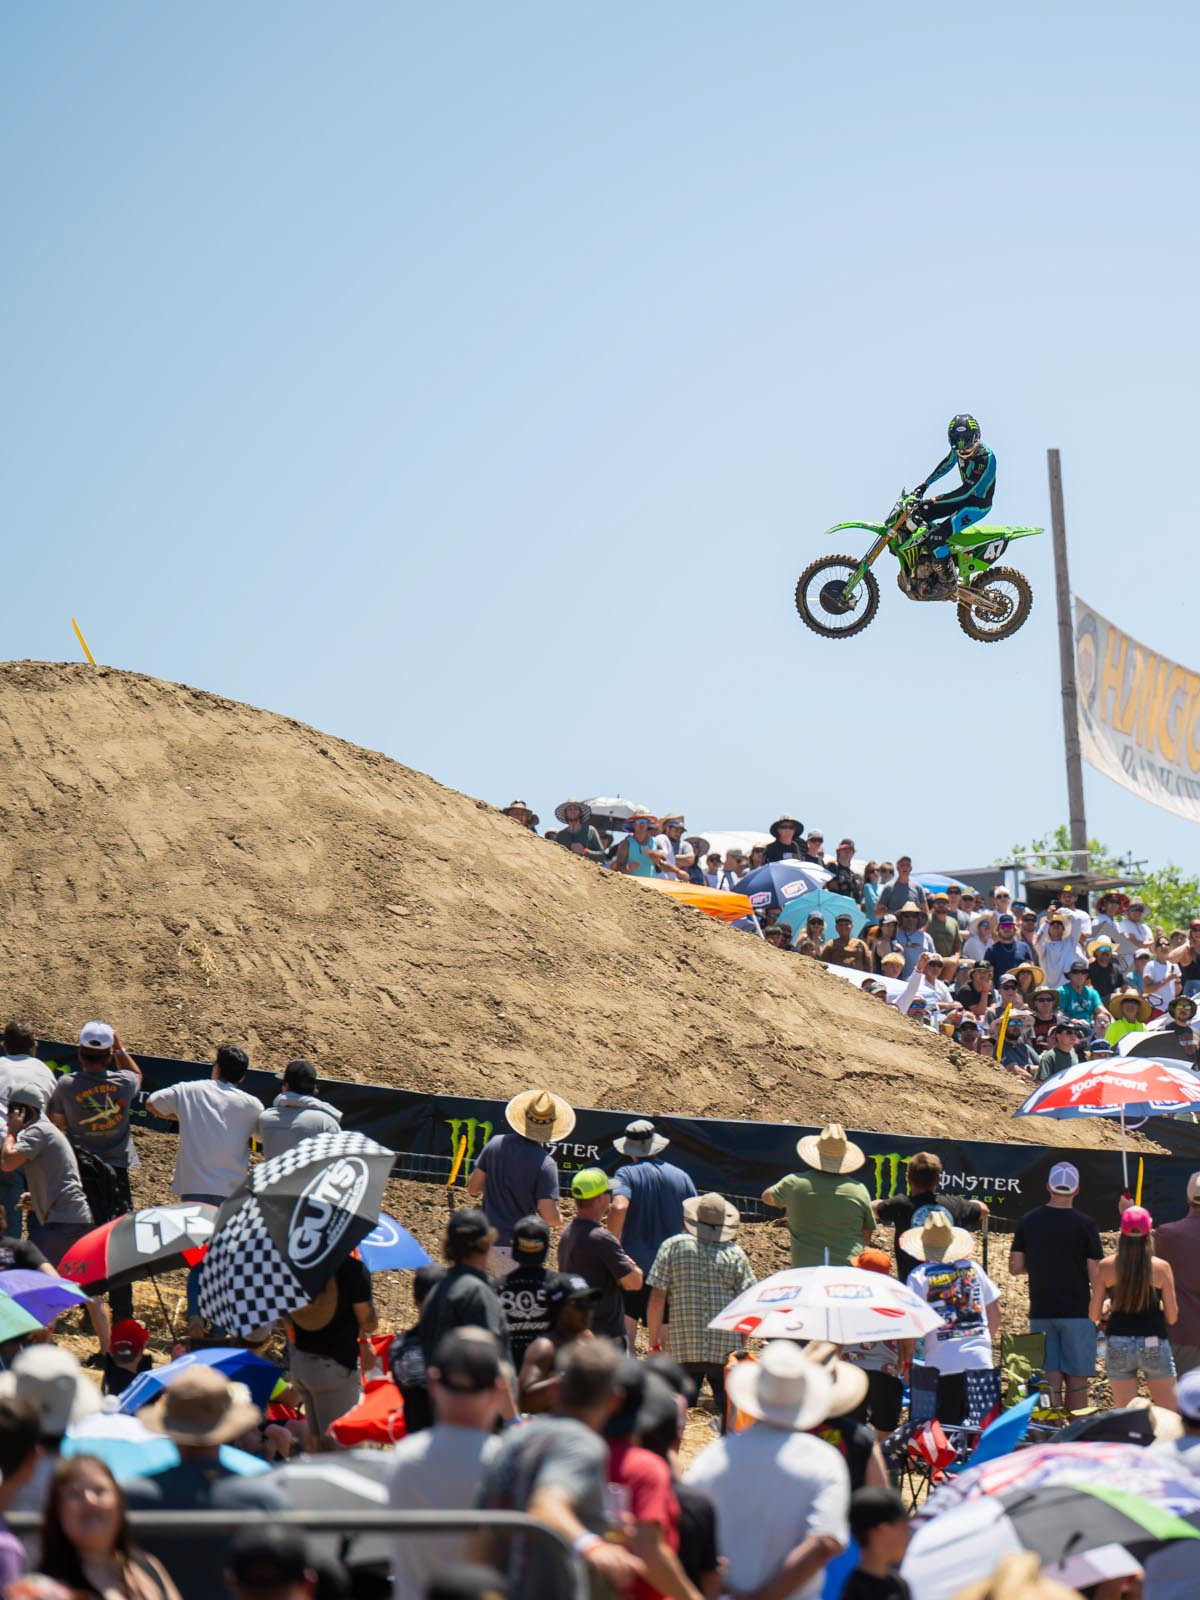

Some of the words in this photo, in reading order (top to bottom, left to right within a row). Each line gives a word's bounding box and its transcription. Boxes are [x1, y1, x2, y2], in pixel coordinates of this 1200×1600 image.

[983, 540, 1005, 560] 47
[938, 1170, 1022, 1194] ONSTER
[288, 1158, 356, 1261] GUTS
